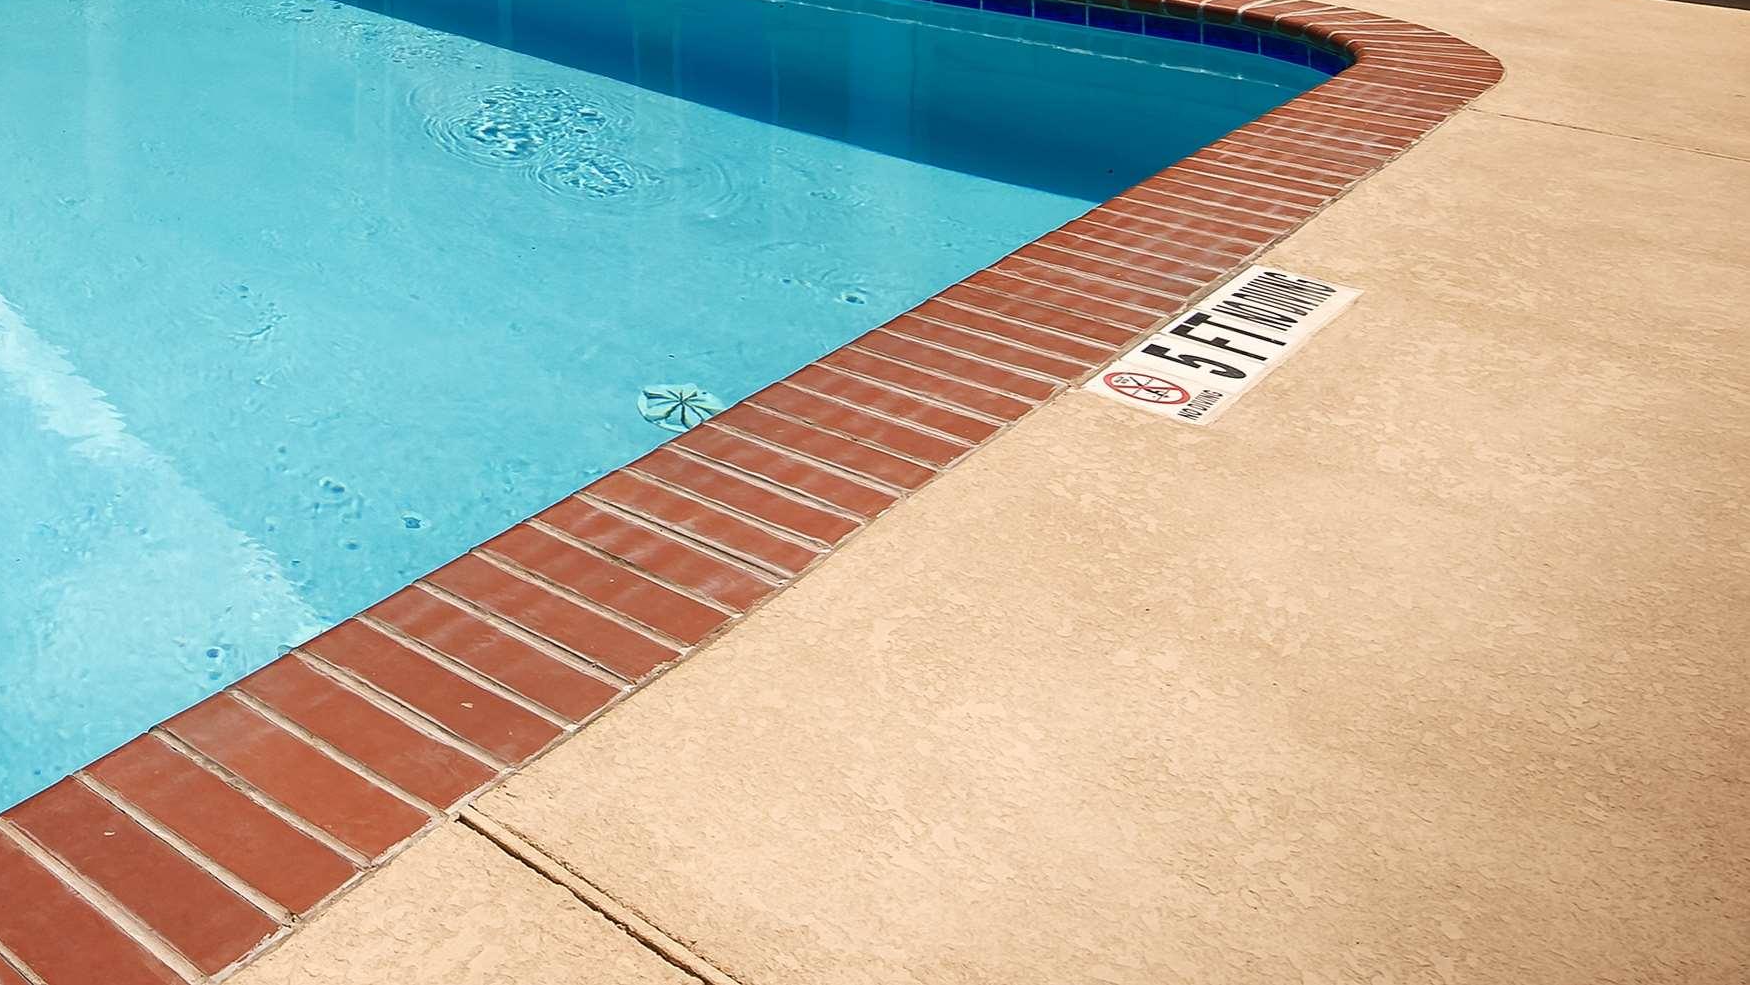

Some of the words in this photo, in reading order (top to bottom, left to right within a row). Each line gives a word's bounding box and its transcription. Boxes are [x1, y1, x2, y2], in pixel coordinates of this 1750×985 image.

[1231, 271, 1337, 317] DIVING
[1211, 300, 1299, 332] NO
[1169, 312, 1288, 362] FT
[1141, 343, 1248, 380] 5
[1177, 408, 1203, 421] NO
[1187, 390, 1223, 412] DIVING
